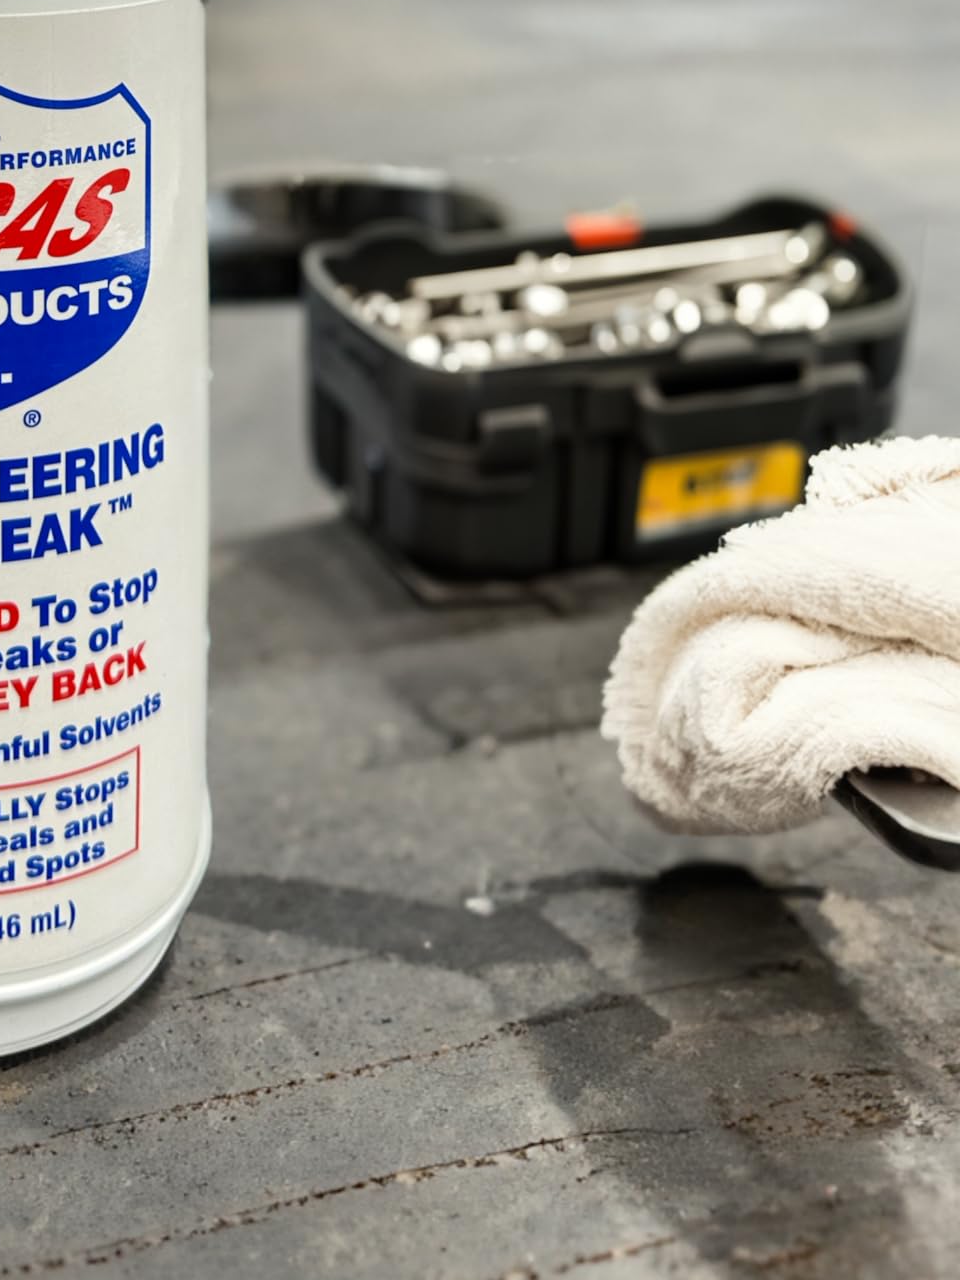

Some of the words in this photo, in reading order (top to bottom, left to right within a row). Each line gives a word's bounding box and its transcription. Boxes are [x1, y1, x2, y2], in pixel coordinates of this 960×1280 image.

[32, 594, 77, 628] To
[89, 568, 158, 615] Stop
[89, 619, 124, 652] or
[51, 641, 148, 704] BACK
[60, 694, 162, 750] Solvents
[55, 769, 130, 812] Stops
[64, 803, 114, 839] and
[26, 838, 106, 881] Spots
[31, 899, 77, 933] mL)
